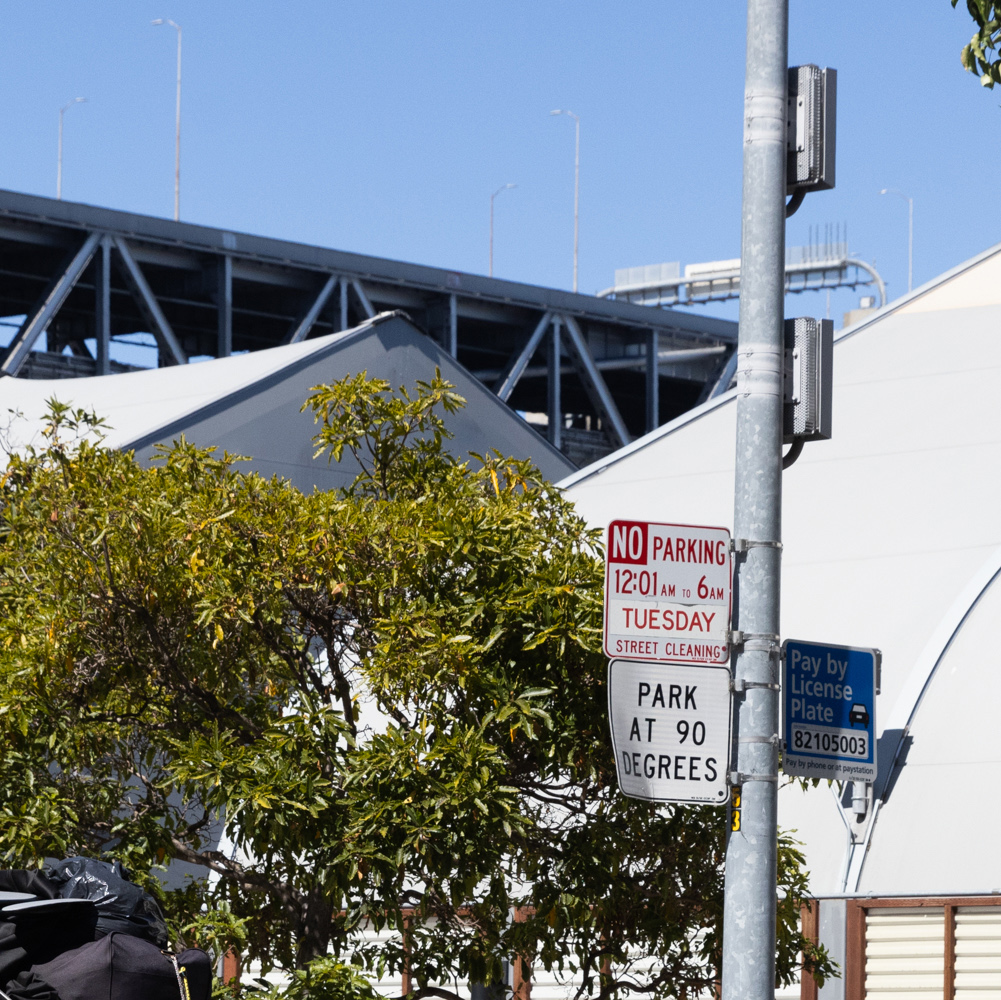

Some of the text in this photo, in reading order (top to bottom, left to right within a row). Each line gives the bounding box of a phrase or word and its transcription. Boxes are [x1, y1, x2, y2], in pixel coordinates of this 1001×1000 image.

[612, 525, 726, 566] NO PARKING
[682, 588, 691, 599] TO
[622, 608, 716, 632] TUESDAY
[616, 640, 721, 659] STREET CLEANING
[791, 649, 848, 681] Pay by
[638, 682, 698, 710] PARK
[791, 674, 853, 701] License
[791, 699, 834, 722] Plate
[629, 717, 706, 746] AT 90
[794, 730, 866, 755] 82105003
[622, 751, 718, 782] DEGREES
[785, 758, 796, 768] Pay
[798, 759, 807, 769] by
[807, 761, 826, 771] phone
[843, 765, 874, 775] paystation
